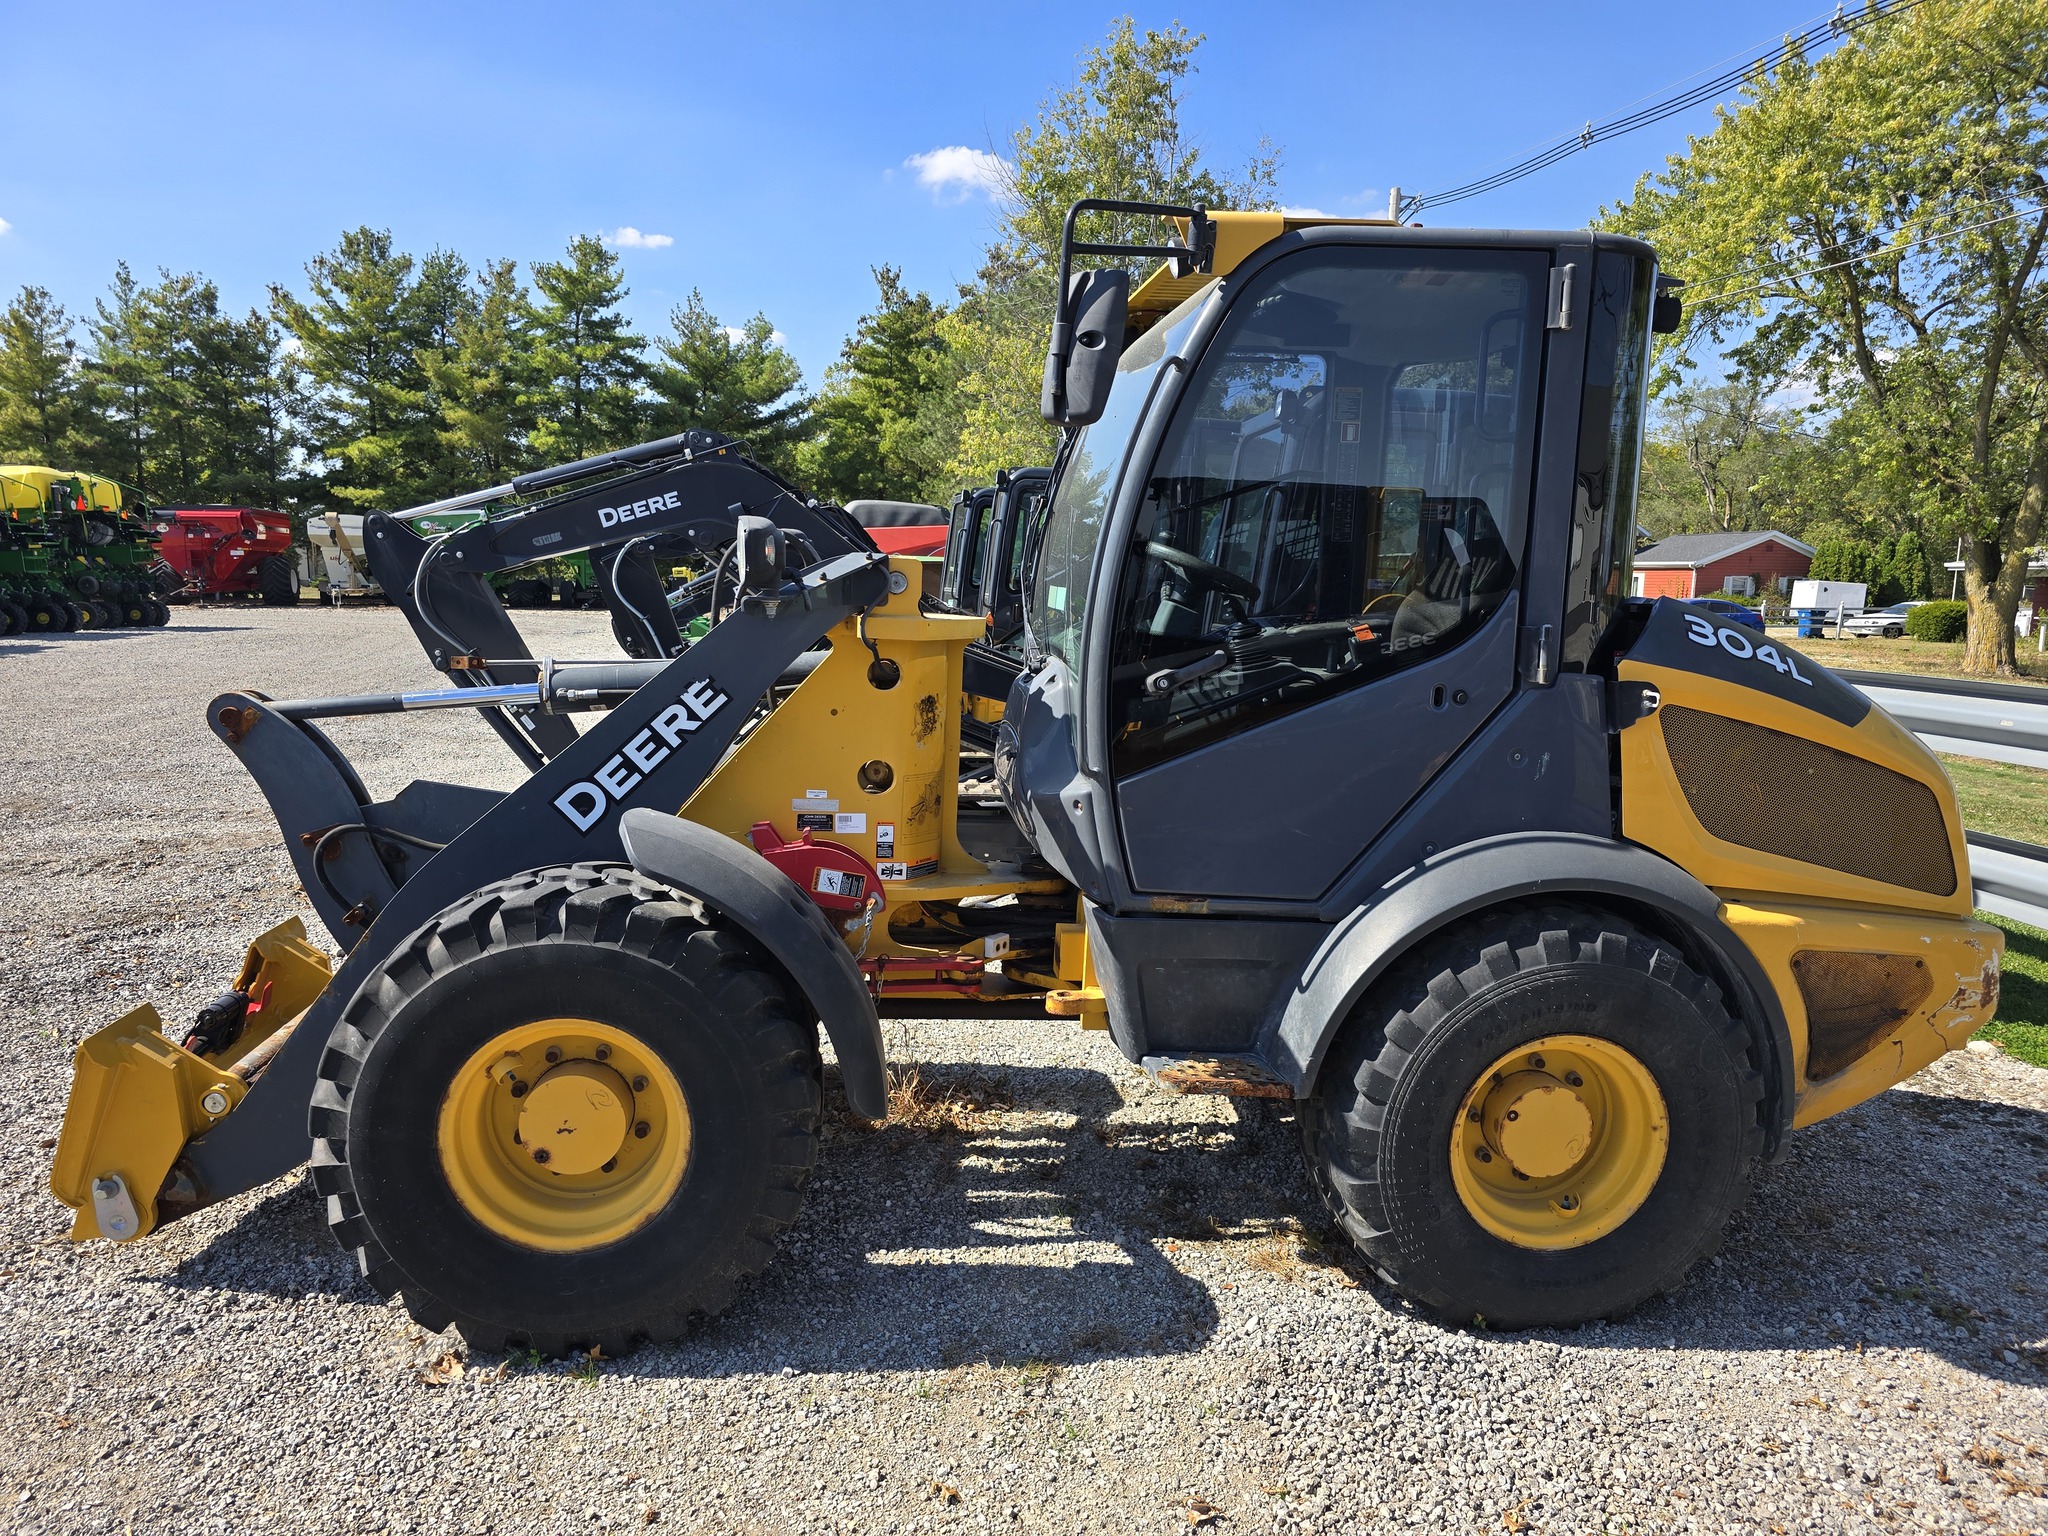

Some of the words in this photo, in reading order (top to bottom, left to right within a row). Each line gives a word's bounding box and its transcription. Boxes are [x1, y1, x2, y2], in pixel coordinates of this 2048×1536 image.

[597, 490, 682, 529] DEERE
[1683, 613, 1813, 687] 304L
[553, 678, 729, 832] DEERE
